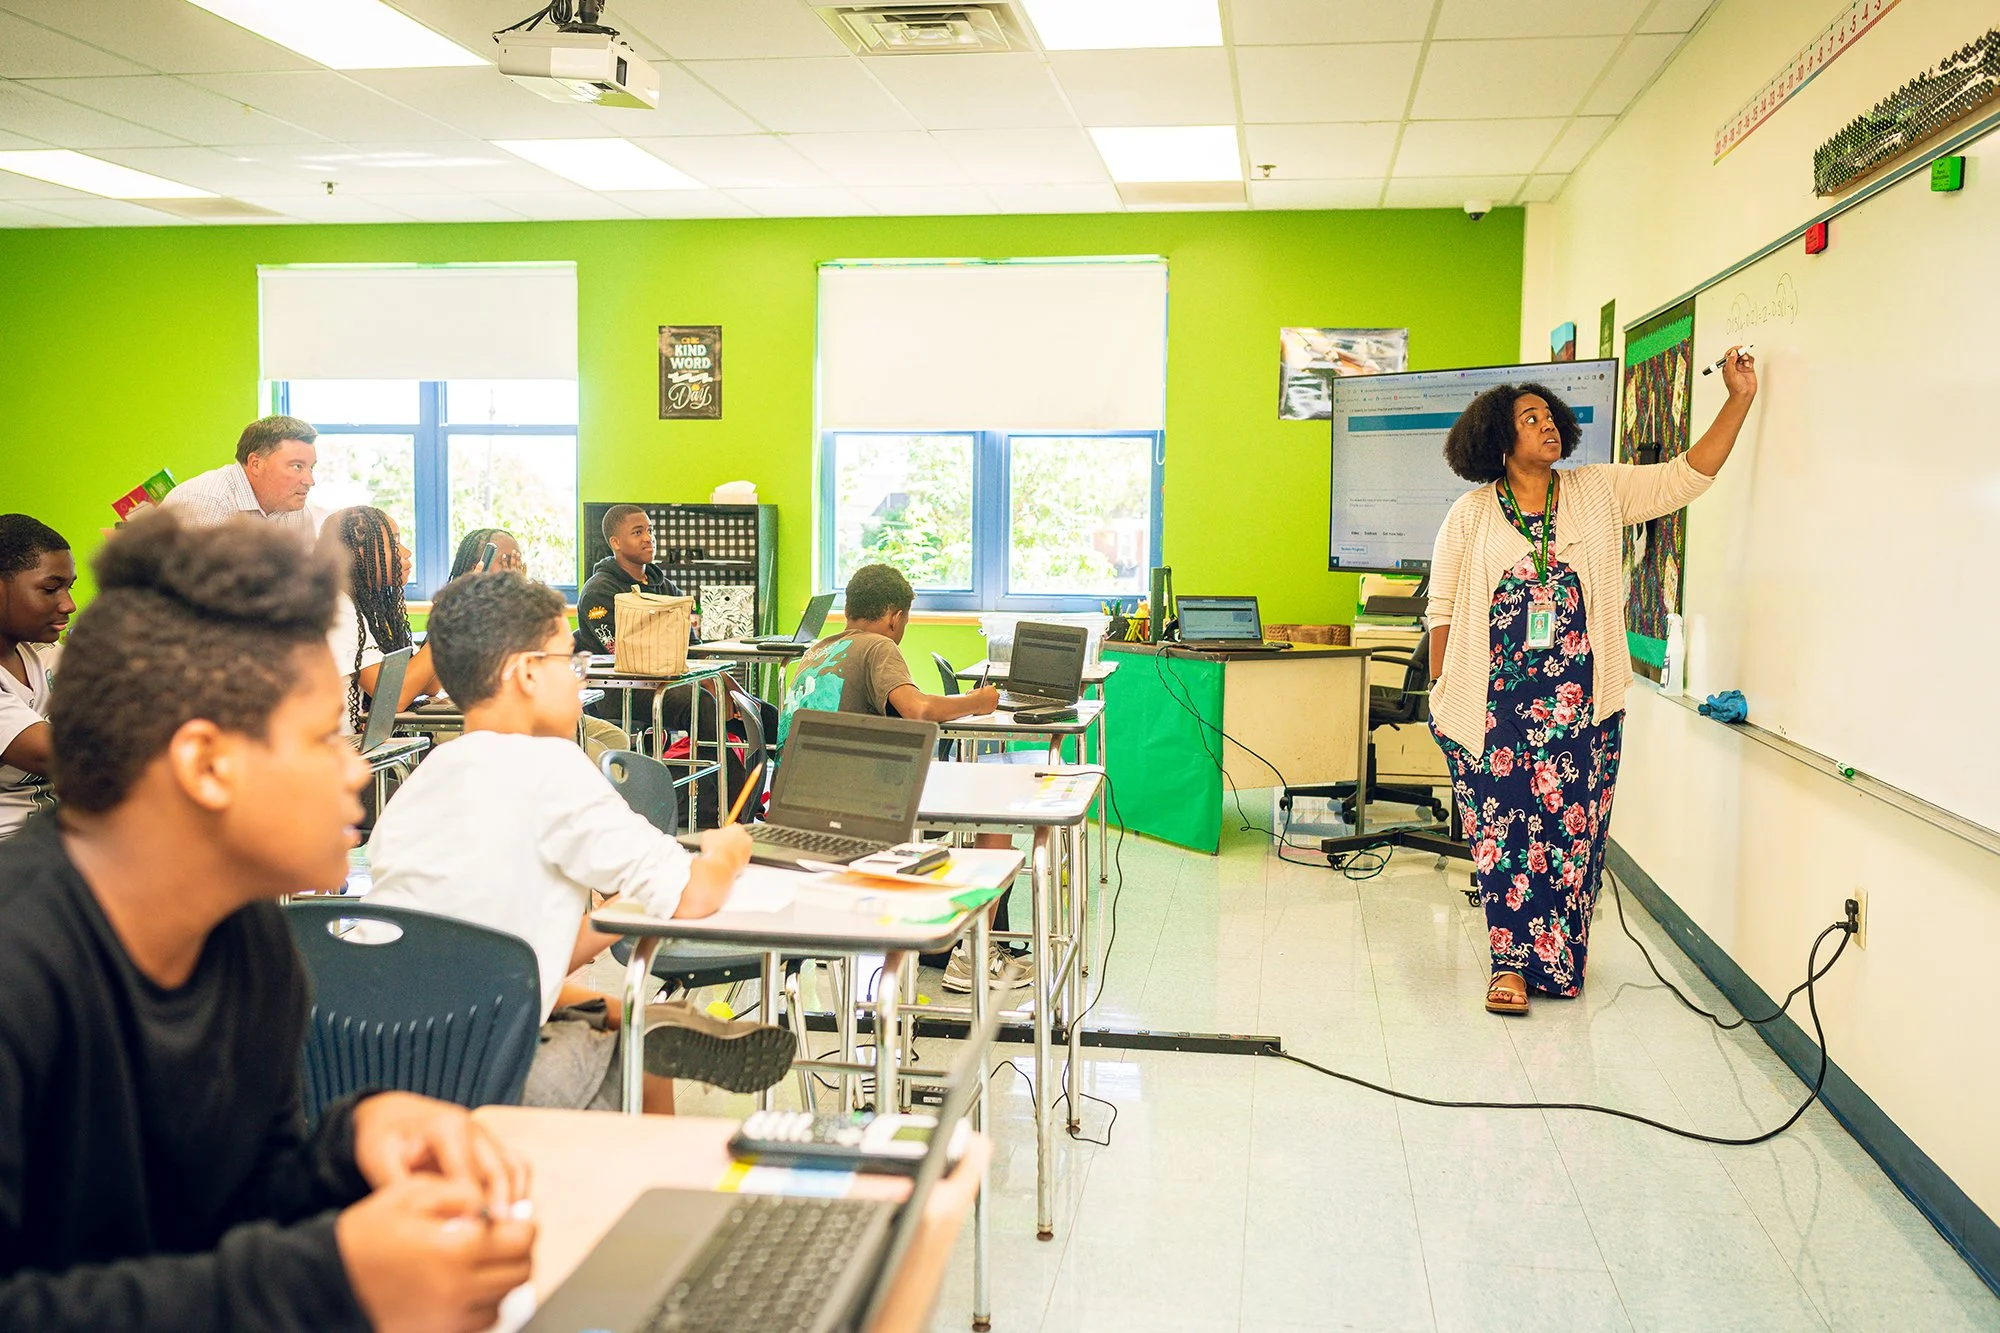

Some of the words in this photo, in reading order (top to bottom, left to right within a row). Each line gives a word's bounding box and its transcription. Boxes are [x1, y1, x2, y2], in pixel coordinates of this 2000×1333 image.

[674, 344, 707, 357] KIND
[670, 357, 711, 369] WORD
[668, 382, 712, 409] Day
